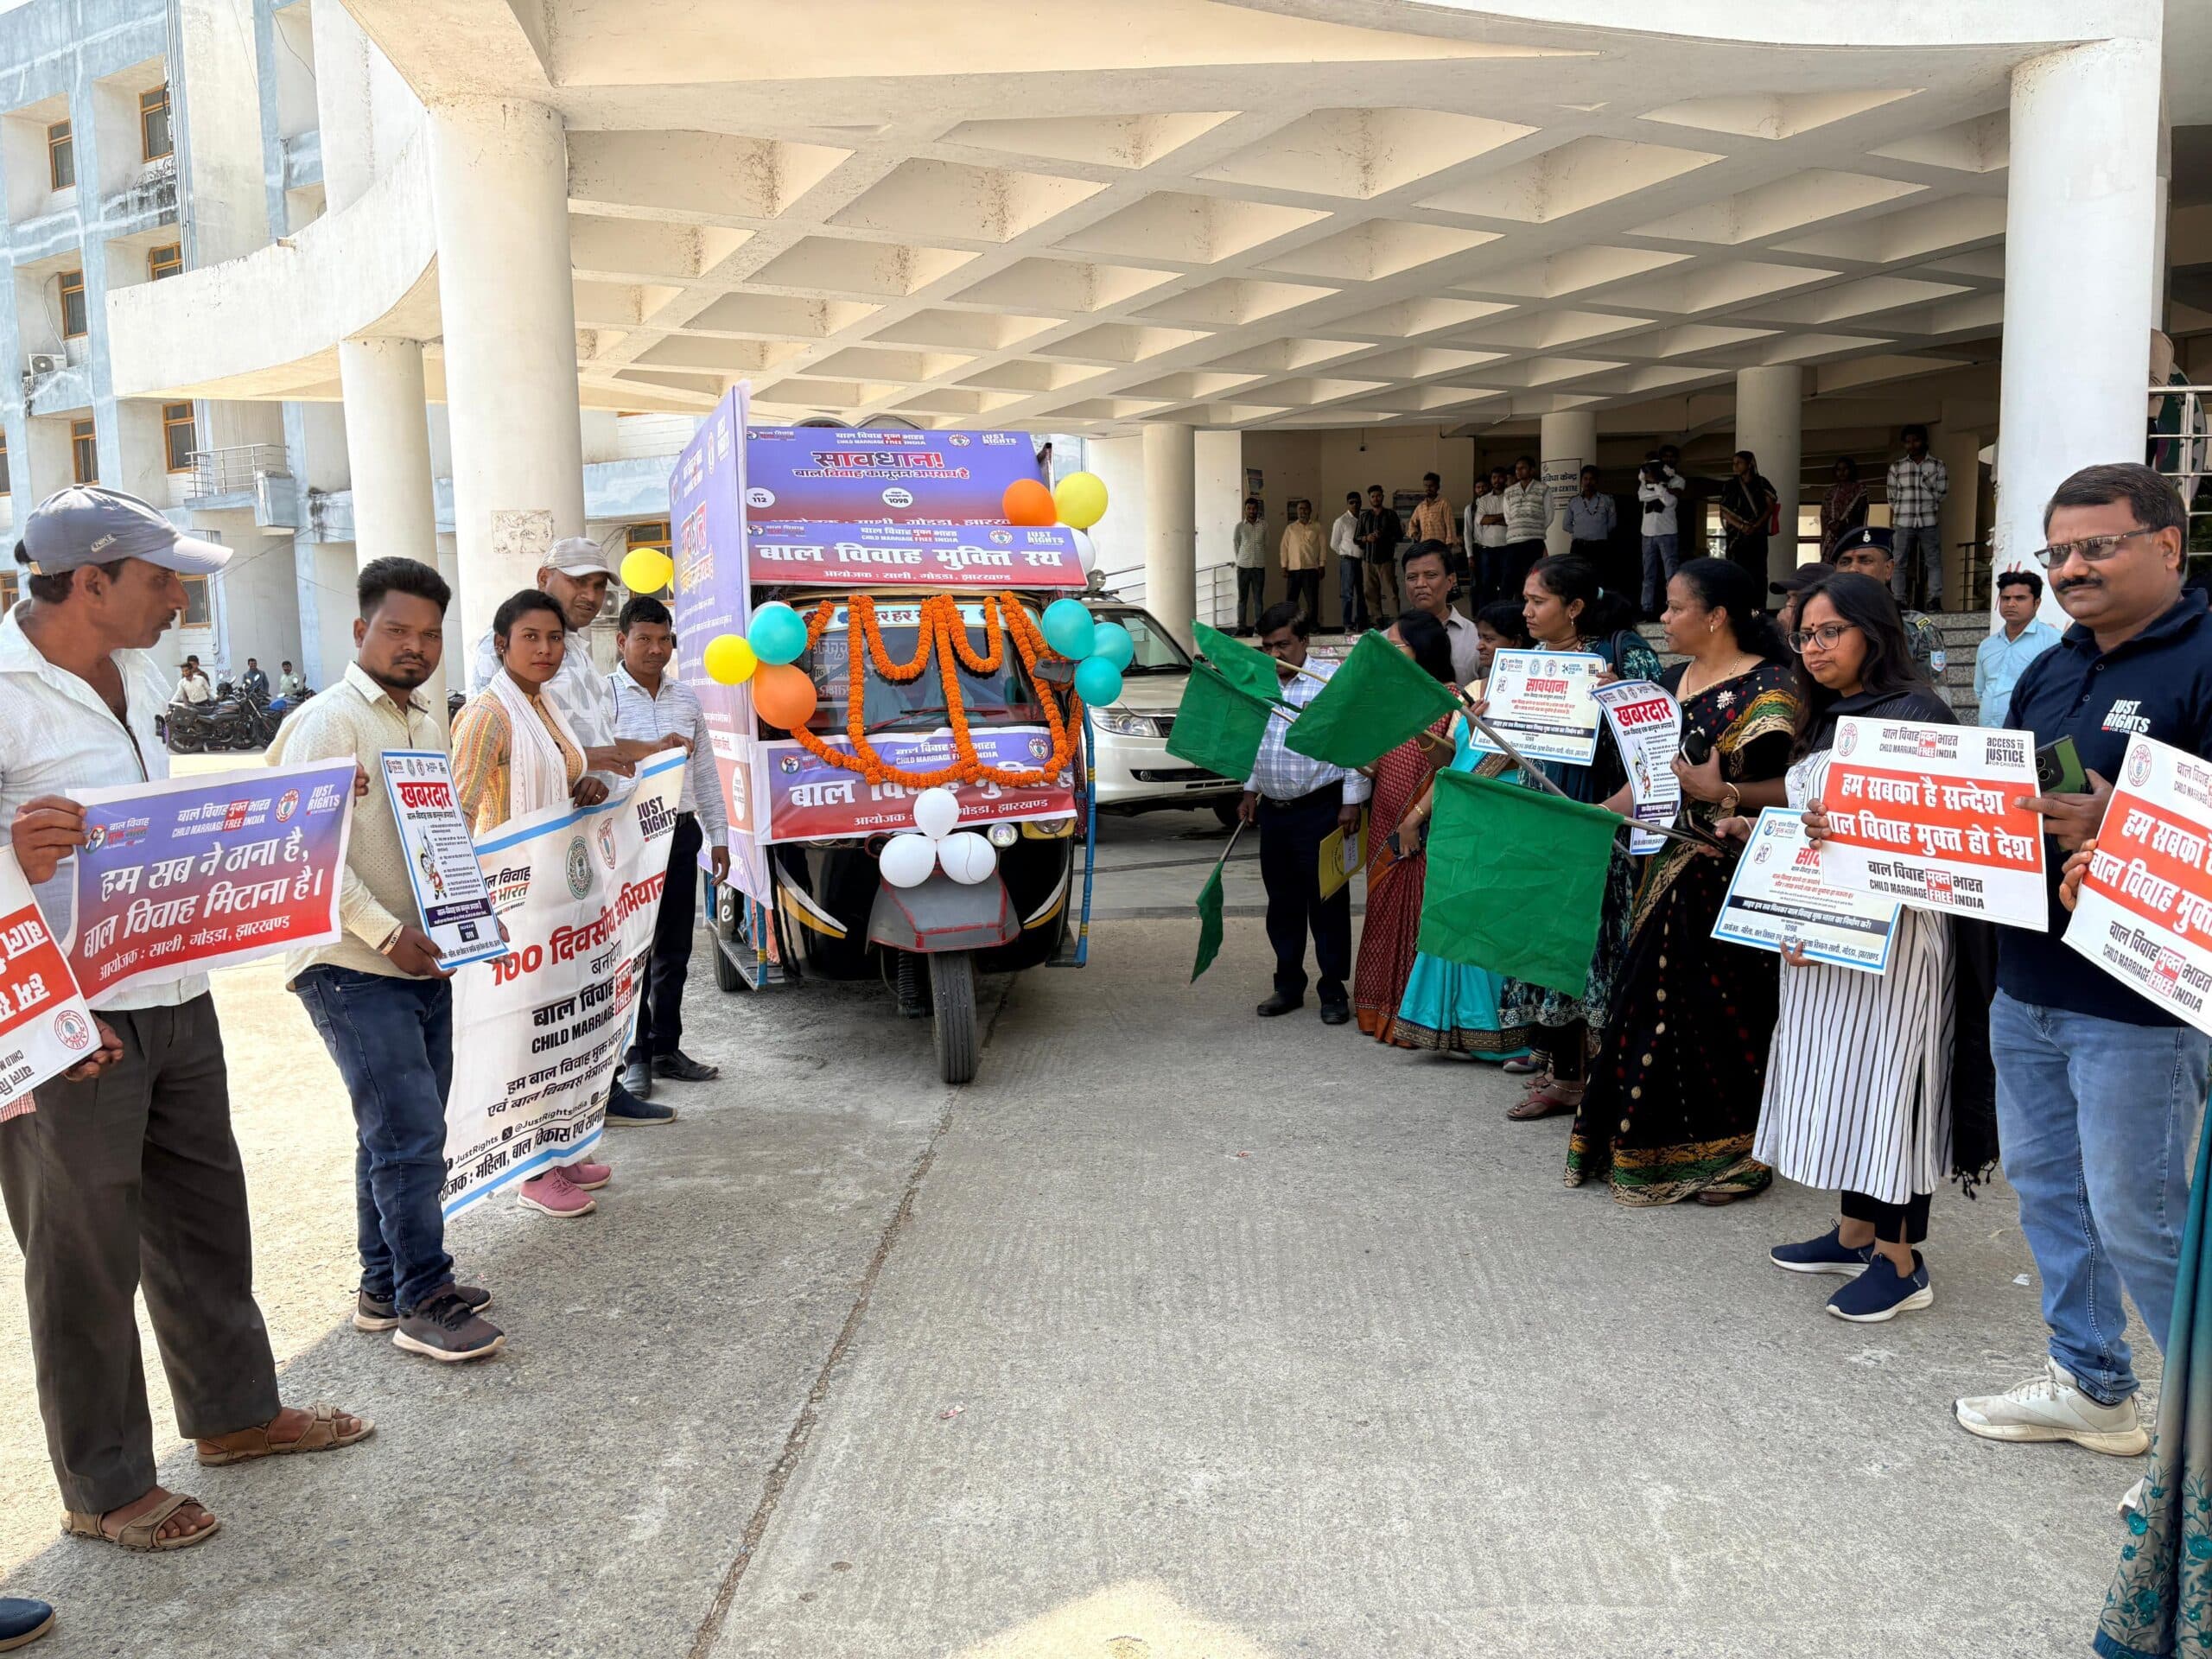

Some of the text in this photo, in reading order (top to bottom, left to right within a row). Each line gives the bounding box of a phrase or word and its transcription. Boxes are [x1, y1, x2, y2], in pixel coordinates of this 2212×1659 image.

[810, 451, 945, 468] सावधान!
[822, 467, 864, 479] विवाह
[957, 467, 970, 479] है
[755, 544, 824, 561] बाल
[834, 543, 923, 563] विवाह
[931, 545, 1013, 570] मुक्ति
[892, 610, 912, 622] हर
[1526, 678, 1568, 694] सावधान!
[1613, 697, 1674, 728] खबरदार
[2109, 699, 2141, 715] JUST
[2102, 713, 2151, 733] RIGHTS
[921, 743, 949, 753] विवाह
[1883, 728, 1897, 741] बाल
[1899, 727, 1919, 741] विवाह
[1937, 734, 1958, 747] भारत
[916, 754, 950, 763] MARRIAGE
[977, 751, 999, 760] NDIA
[1879, 744, 1957, 760] CHILD MARRIAGE FREE INDIA
[1986, 748, 2024, 765] JUSTICE
[2177, 761, 2210, 787] बाल विवाह
[308, 794, 340, 811] RIGHTS
[312, 784, 334, 798] JUST
[397, 782, 453, 810] खबरदार
[789, 779, 855, 807] बाल
[1841, 772, 2005, 815] हम सबका है सन्देश
[2174, 780, 2208, 805] CHILD MARRIAGE
[177, 798, 271, 822] बाल विवाह मुक्त भारत
[637, 796, 664, 820] JUST
[639, 807, 677, 836] RIGHTS
[854, 799, 1048, 826] आयोजक झारखण्ड
[127, 817, 150, 828] विवाह
[172, 815, 265, 838] CHILD MARRIAGE FREE INDIA
[1859, 810, 2035, 861] विवाह मुक्त हो देश
[2121, 808, 2157, 844] हम
[2152, 819, 2208, 870] सबका
[100, 826, 309, 902] हम सब ने ठाना है,
[499, 866, 531, 885] विवाह
[1867, 861, 1983, 893] बाल विवाह मुक्त भारत
[499, 881, 530, 900] भारत
[2088, 849, 2181, 912] बाल विवाह
[1870, 879, 1985, 910] CHILD MARRIAGE FREE INDIA
[84, 913, 119, 959] बाल
[123, 894, 200, 940] विवाह
[203, 878, 290, 919] मिटाना
[492, 870, 666, 986] 100 दिवसीय अभियान
[99, 946, 139, 982] आयोजक
[235, 914, 290, 942] झारखण्ड
[2109, 920, 2212, 994] बाल विवाह मुक्त भारत
[2103, 944, 2204, 1013] CHILD MARRIAGE FREE INDIA
[10, 973, 51, 1012] हम
[532, 994, 576, 1028] बाल
[580, 977, 614, 1012] विवाह
[532, 1029, 569, 1054] CHILD
[572, 1005, 614, 1041] MARRIAGE
[615, 988, 632, 1013] FREE
[5, 1049, 24, 1066] CHILD
[9, 1065, 35, 1085] बाल
[507, 1078, 526, 1096] हम
[529, 1064, 556, 1086] बाल
[560, 1048, 591, 1076] विवाह
[487, 1074, 583, 1118] एवं बाल विकास
[455, 1134, 499, 1165] JustRights
[475, 1116, 584, 1179] महिला, बाल विकास एवं
